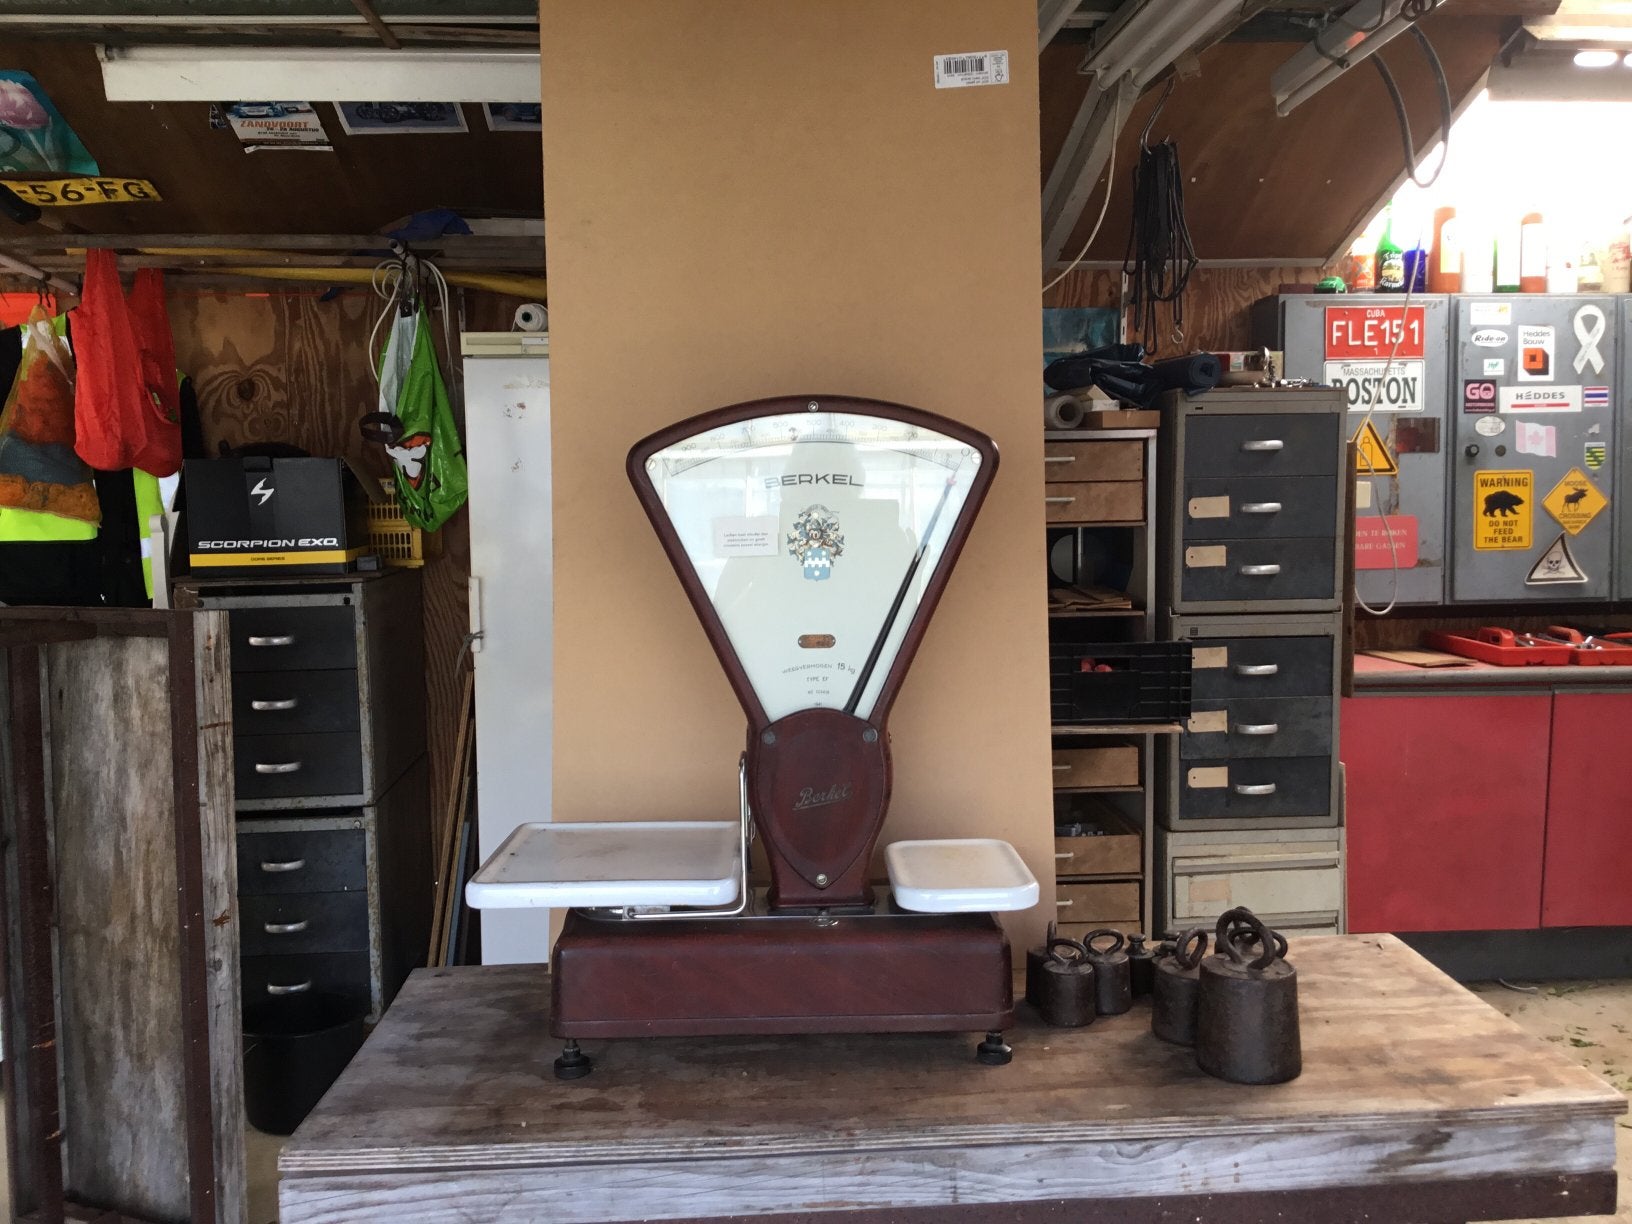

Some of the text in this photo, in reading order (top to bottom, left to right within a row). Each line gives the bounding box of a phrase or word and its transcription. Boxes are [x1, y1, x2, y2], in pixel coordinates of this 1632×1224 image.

[241, 120, 308, 128] ZANDVOORT
[1366, 309, 1385, 318] CUBA
[1332, 320, 1419, 346] FLE151
[1343, 366, 1406, 376] MASSACHUETTS
[1466, 383, 1495, 400] GO
[764, 473, 864, 489] BERKEL
[1480, 477, 1528, 487] WARNING
[198, 539, 295, 549] SCORPION
[1376, 542, 1406, 550] GASEN
[837, 662, 846, 670] 15
